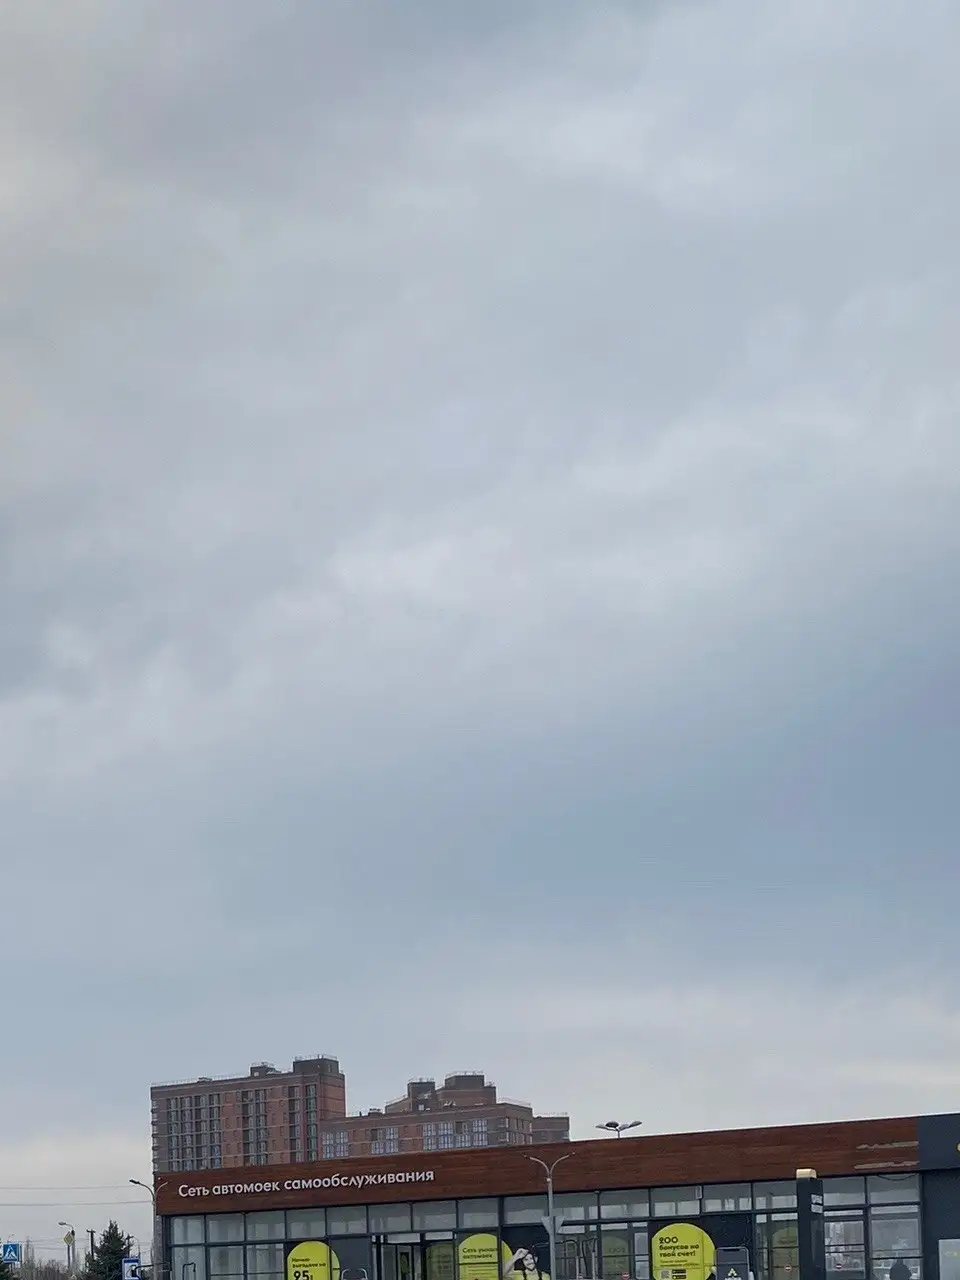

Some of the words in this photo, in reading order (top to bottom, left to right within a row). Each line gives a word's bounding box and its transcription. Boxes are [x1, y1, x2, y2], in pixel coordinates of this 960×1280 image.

[178, 1183, 210, 1197] Сеть
[212, 1179, 280, 1196] автомоек
[284, 1170, 435, 1191] самообслуживания
